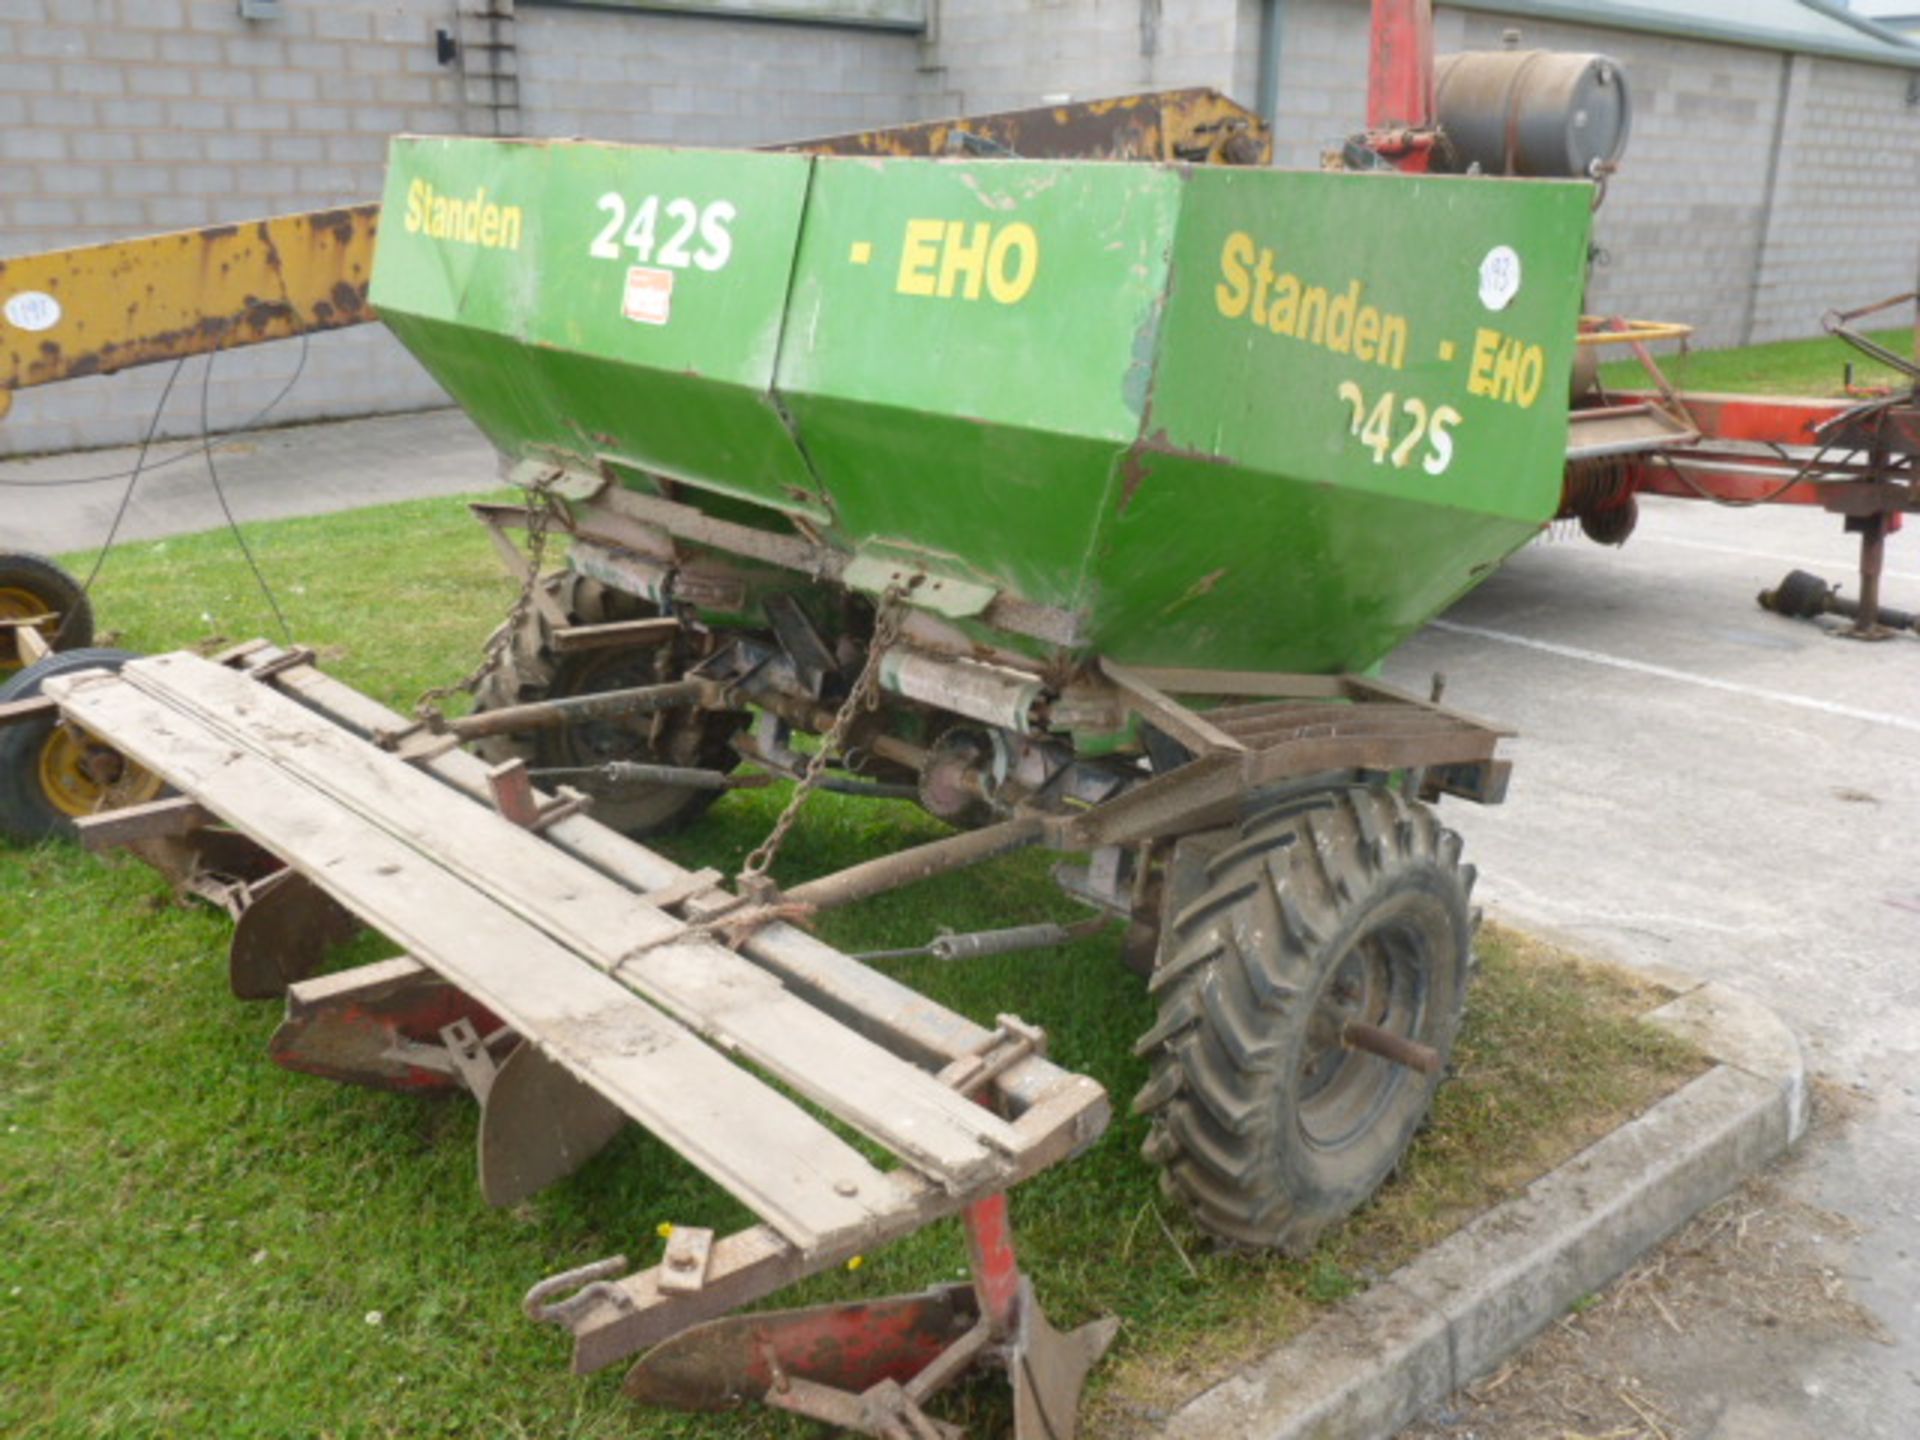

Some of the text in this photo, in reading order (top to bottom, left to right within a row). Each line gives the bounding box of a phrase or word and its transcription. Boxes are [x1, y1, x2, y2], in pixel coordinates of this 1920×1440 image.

[405, 178, 521, 250] Standen
[590, 192, 736, 271] 242S
[897, 218, 1038, 304] EHO
[1215, 231, 1408, 370] Standen
[1467, 328, 1544, 408] EHO
